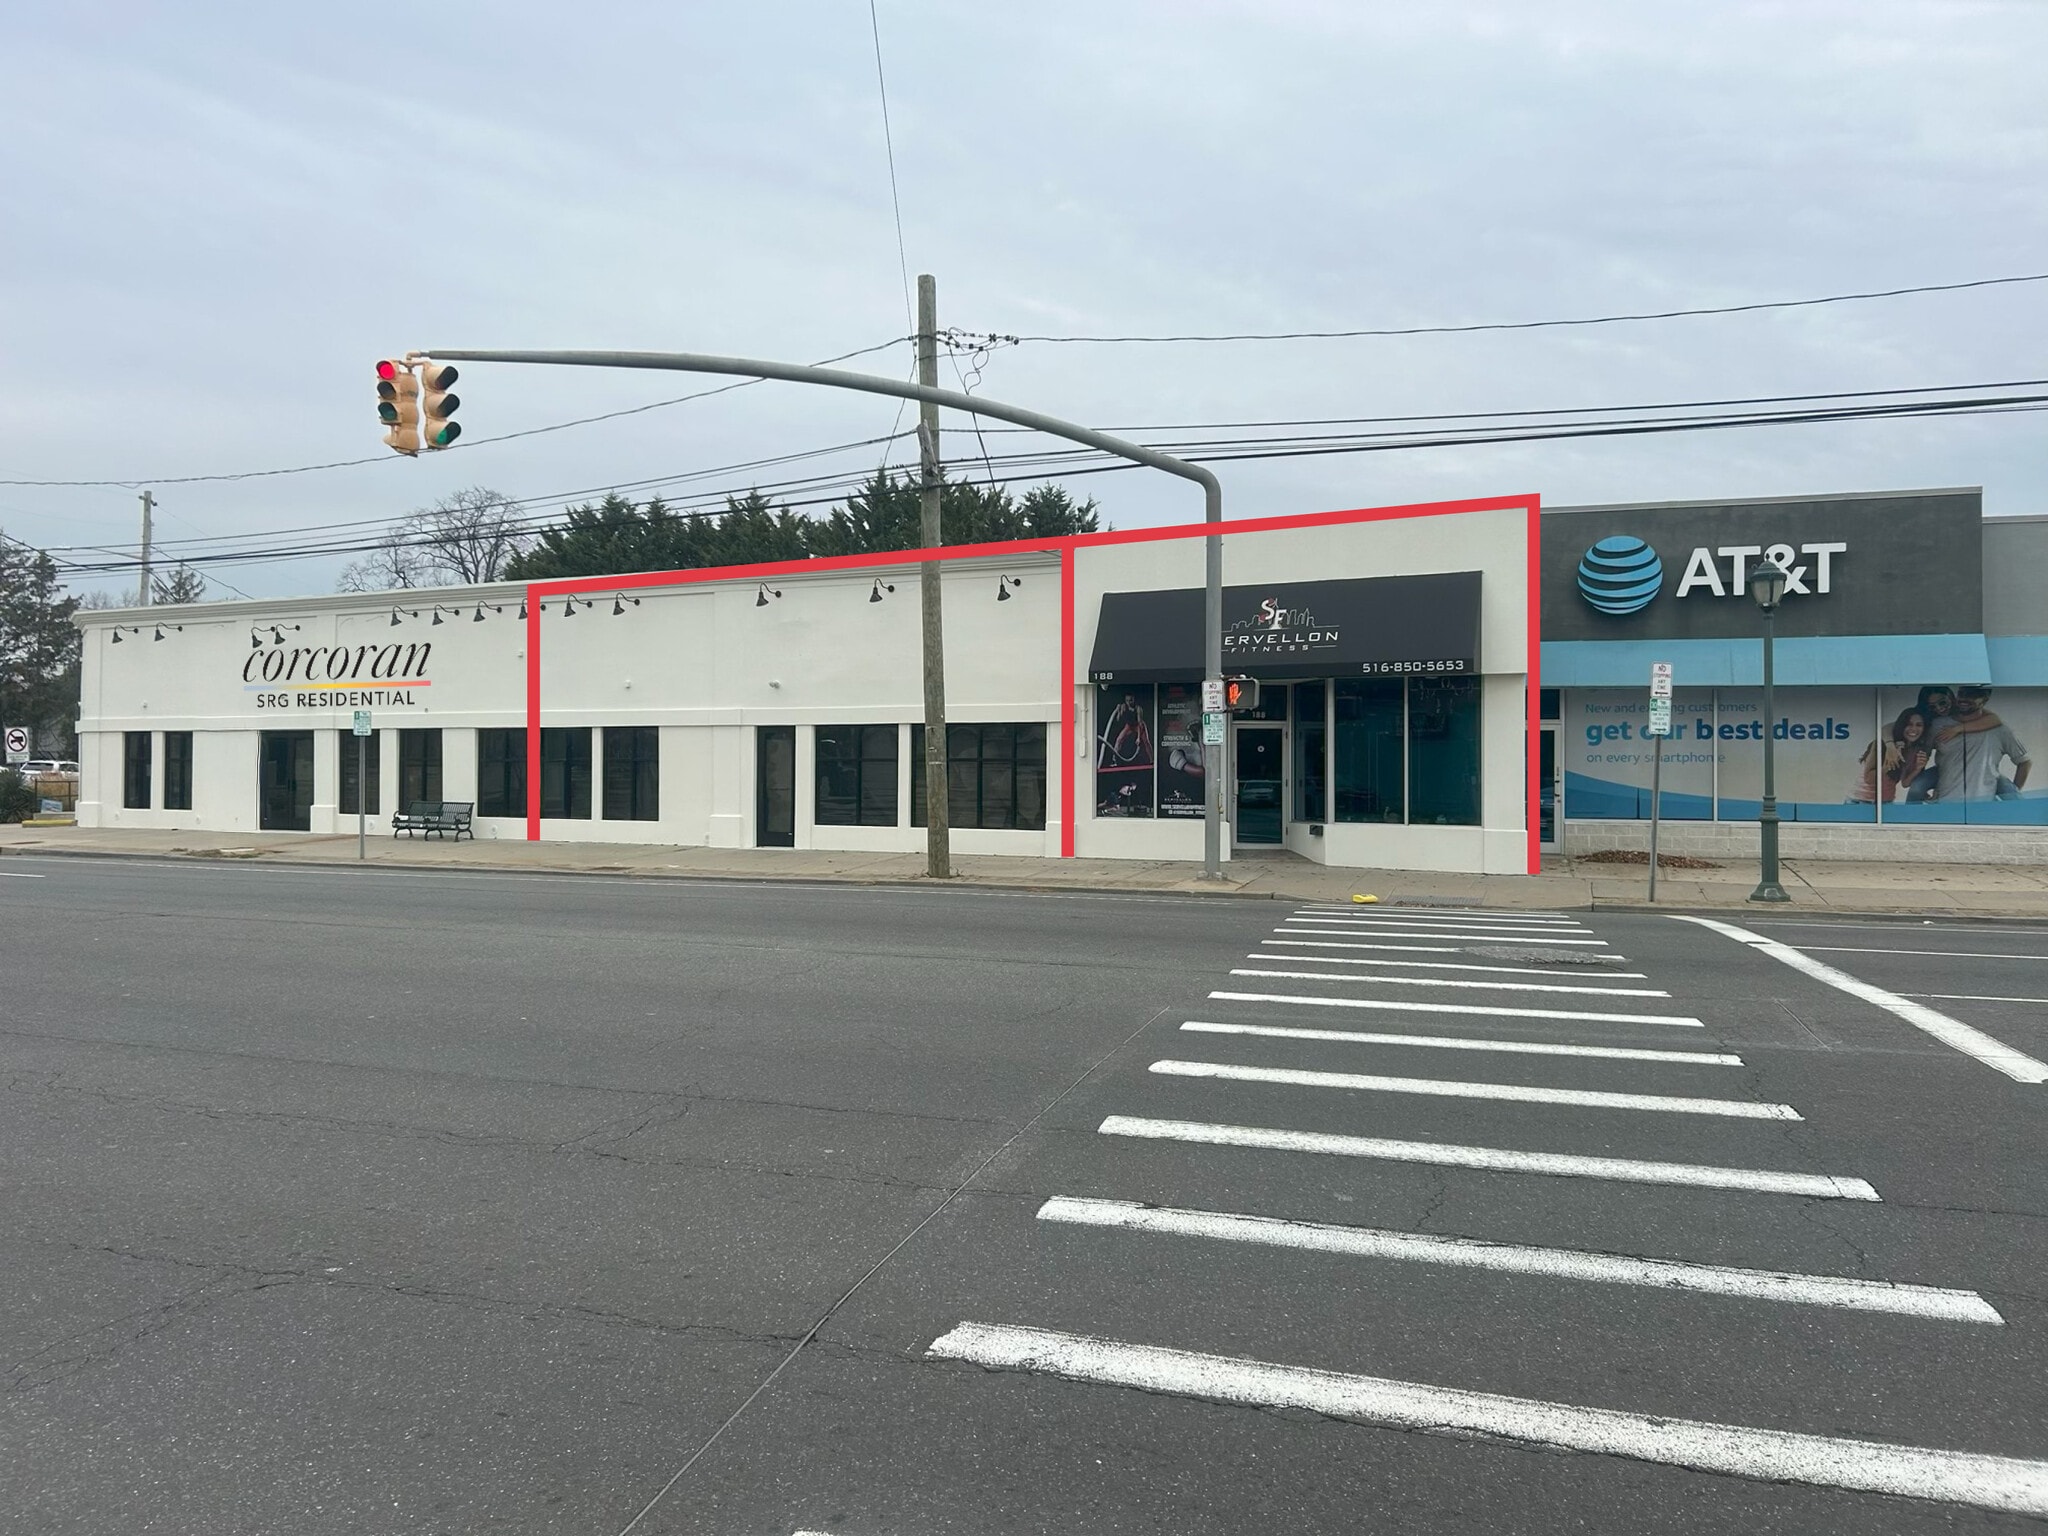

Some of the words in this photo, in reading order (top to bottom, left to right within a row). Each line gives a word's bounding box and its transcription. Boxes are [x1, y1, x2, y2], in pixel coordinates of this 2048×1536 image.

[1676, 542, 1847, 597] AT&T
[1224, 631, 1339, 646] ERVELLON
[1230, 644, 1309, 653] FITNESS
[242, 642, 432, 682] corcoran
[1362, 660, 1464, 673] 516-850-5653
[1094, 672, 1113, 680] 188
[257, 693, 289, 708] SRG
[297, 690, 415, 707] RESIDENTIAL
[1585, 703, 1611, 713] New
[1614, 703, 1636, 713] and
[1688, 703, 1758, 712] customers
[1586, 721, 1632, 746] get
[1696, 718, 1763, 740] best
[1773, 718, 1850, 740] deals
[1586, 754, 1601, 763] on
[1606, 754, 1640, 765] every
